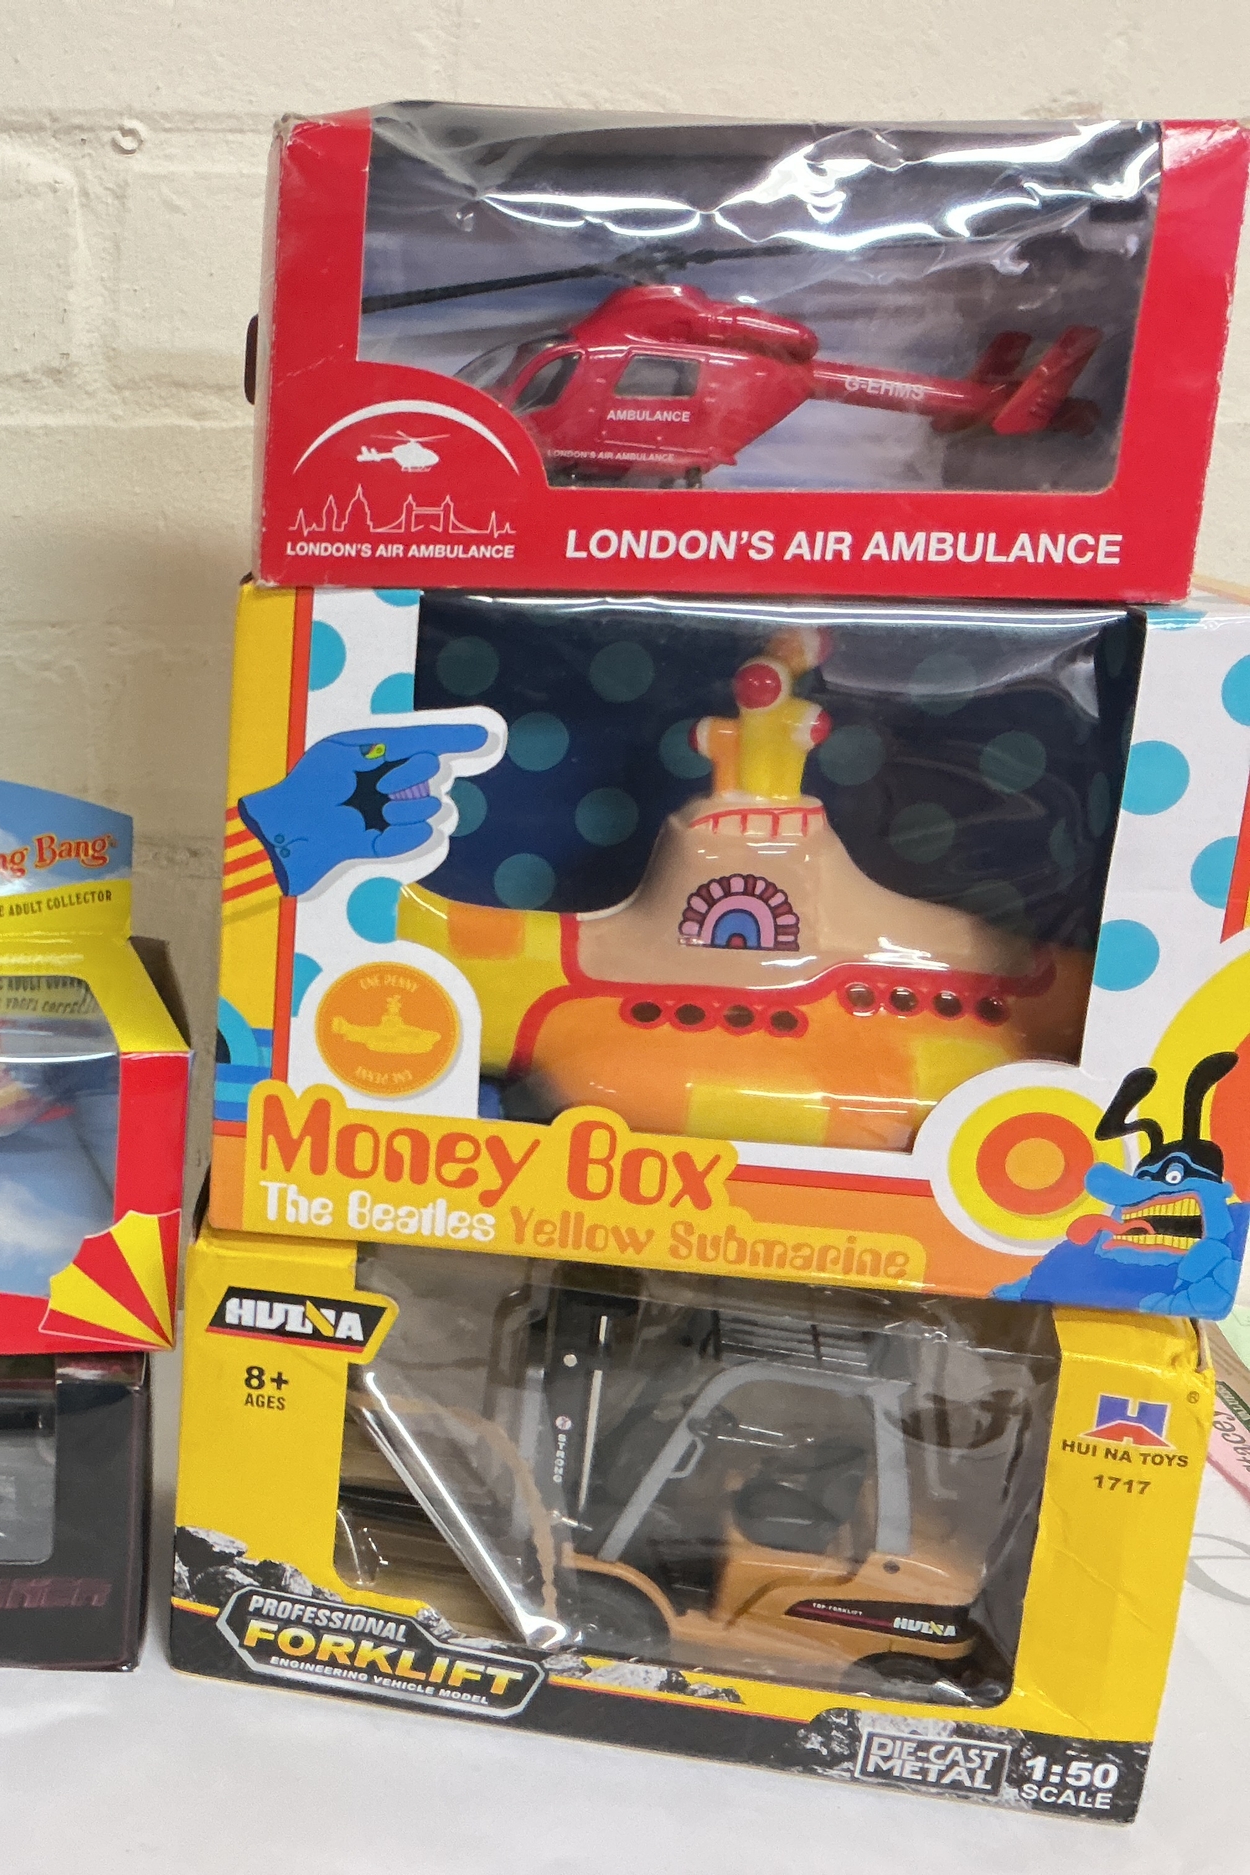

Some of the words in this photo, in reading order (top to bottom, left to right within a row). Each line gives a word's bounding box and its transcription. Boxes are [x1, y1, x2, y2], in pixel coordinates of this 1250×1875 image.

[844, 375, 926, 401] G-EHMS
[606, 409, 691, 423] AMBULANCE
[597, 452, 614, 462] AIR
[615, 453, 675, 463] AMBULANCE
[286, 541, 372, 558] LONDON'S
[375, 543, 404, 558] AIR
[407, 544, 515, 559] AMBULANCE
[565, 528, 774, 561] LONDON'S
[783, 531, 851, 562] AIR
[862, 531, 1123, 566] AMBULANCE
[8, 900, 43, 917] ADULT
[46, 889, 113, 911] COLLECTOR
[259, 1093, 541, 1208] Money
[567, 1119, 721, 1211] Box
[260, 1180, 334, 1227] The
[347, 1190, 496, 1242] Beatles
[510, 1205, 655, 1256] Yellow
[668, 1220, 911, 1281] Submarine
[225, 1297, 364, 1341] HUINA
[244, 1365, 289, 1391] 8+
[244, 1393, 286, 1411] AGES
[553, 1433, 568, 1483] STRONG
[1062, 1438, 1097, 1457] HUI
[1103, 1447, 1132, 1464] NA
[1138, 1452, 1189, 1468] TOYS
[1093, 1473, 1152, 1496] 1717
[248, 1595, 406, 1643] PROFESSIONAL
[893, 1616, 957, 1638] HUINA
[243, 1619, 523, 1695] FORKLIFT
[269, 1655, 368, 1682] ENGINEERING
[373, 1674, 434, 1695] VEHICLE
[438, 1688, 489, 1705] MODEL
[870, 1736, 999, 1772] DIE-CAST
[866, 1755, 992, 1790] METAL
[1025, 1754, 1119, 1790] 1:50
[1021, 1782, 1113, 1810] SCALE
